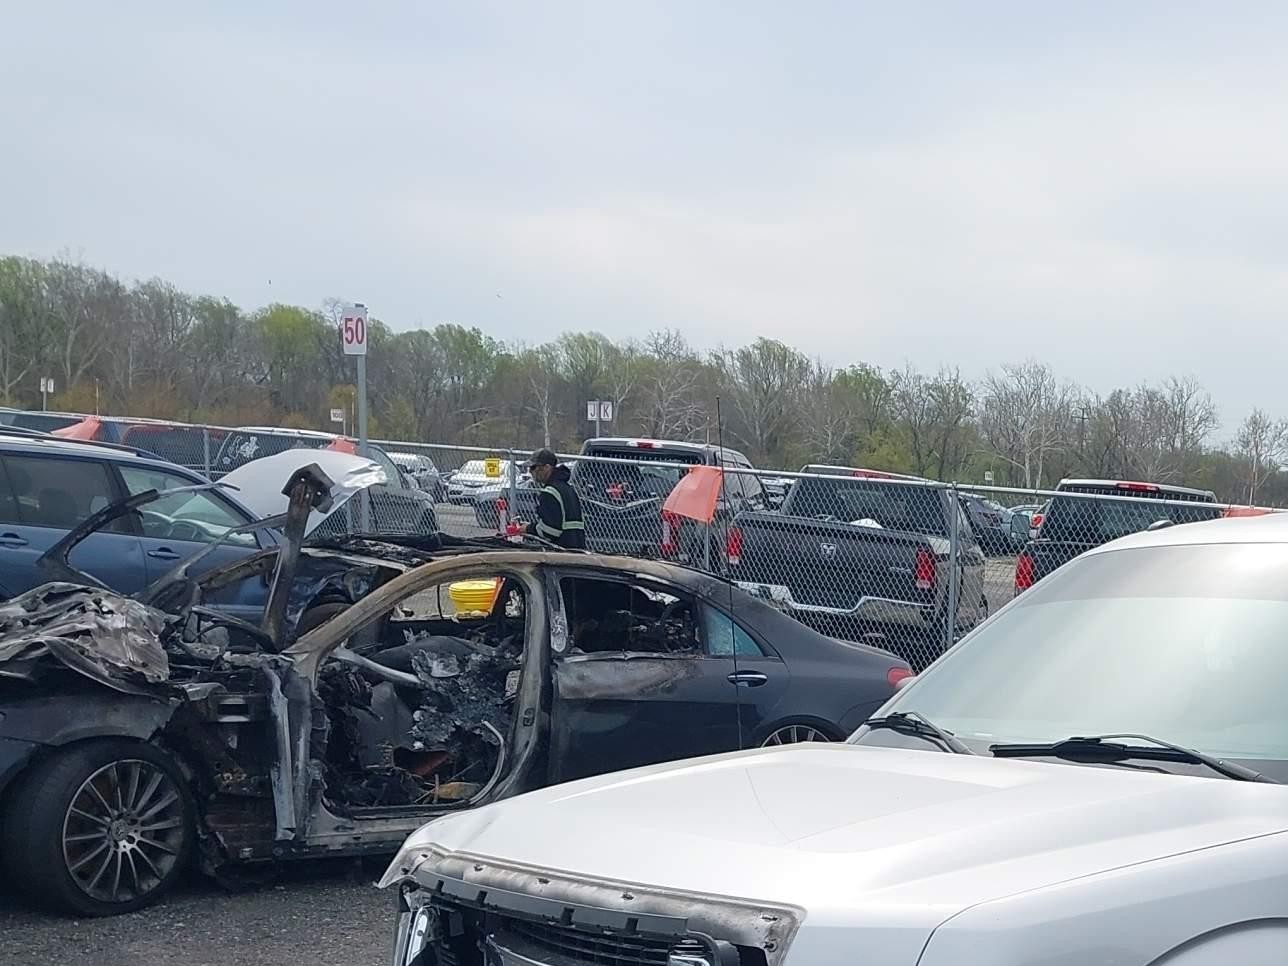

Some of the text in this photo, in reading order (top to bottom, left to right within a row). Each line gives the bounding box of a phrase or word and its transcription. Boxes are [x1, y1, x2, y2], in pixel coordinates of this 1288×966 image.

[344, 317, 365, 345] 50
[590, 403, 596, 418] J
[603, 403, 610, 418] K
